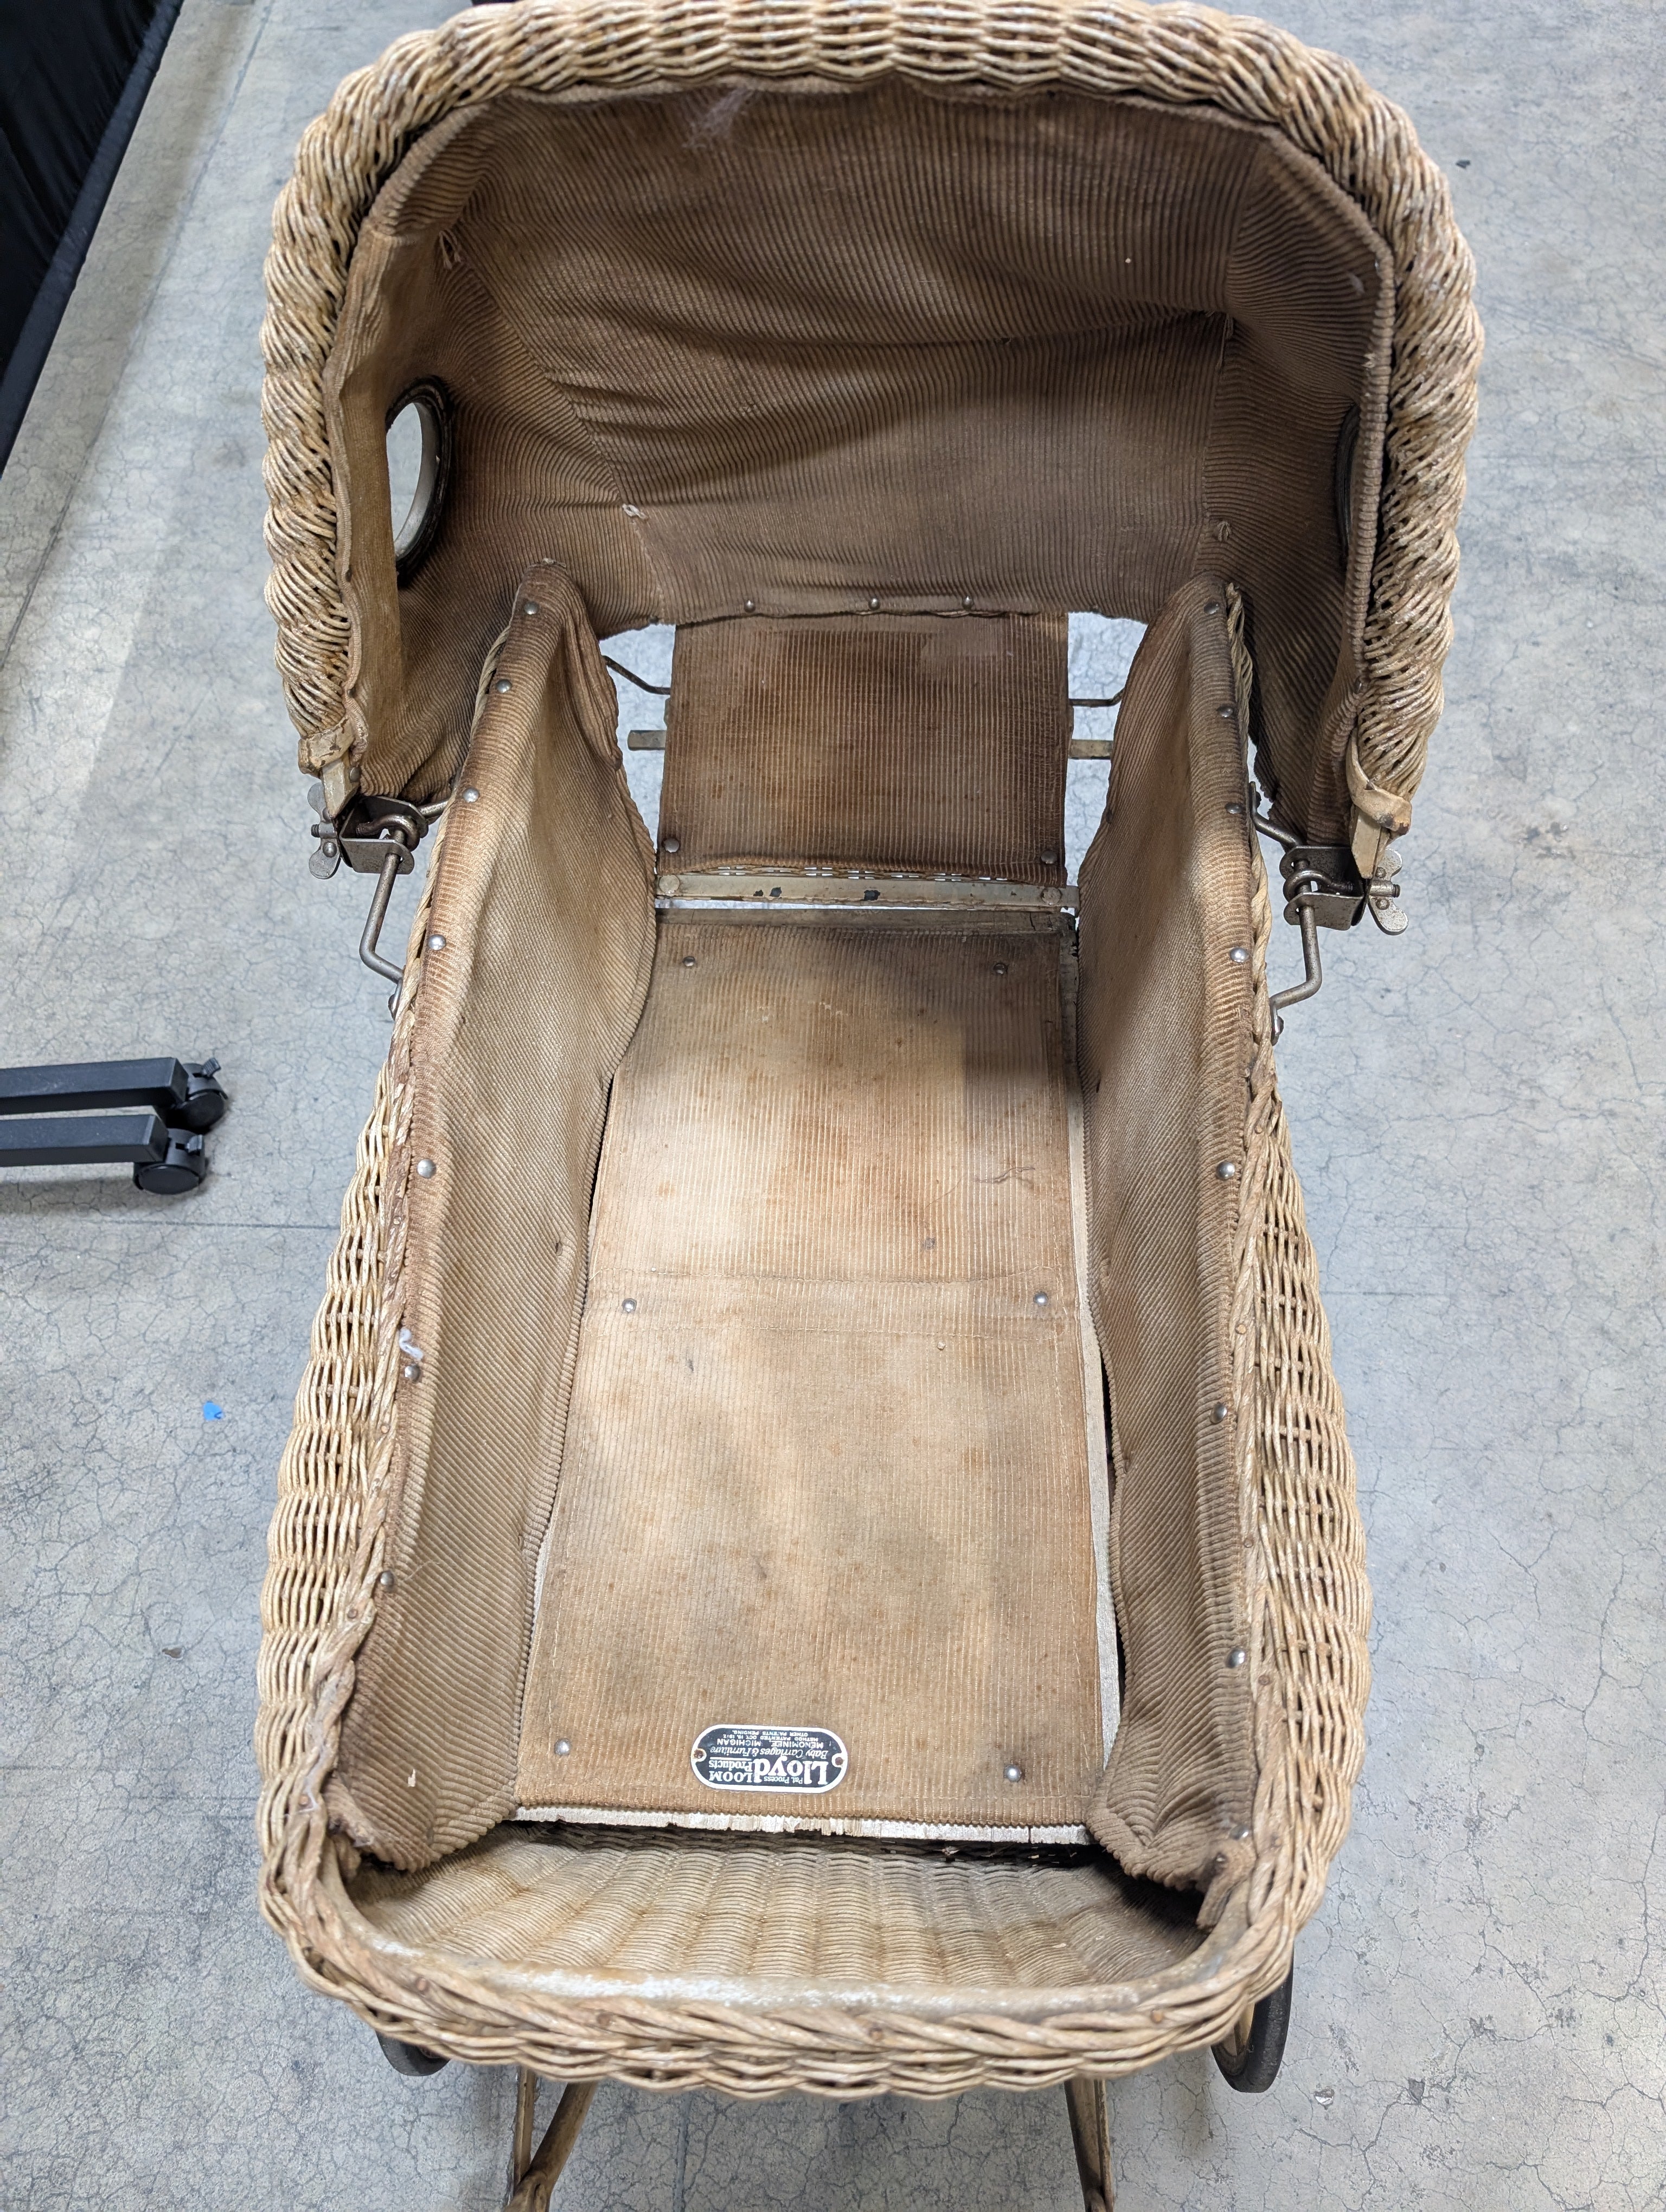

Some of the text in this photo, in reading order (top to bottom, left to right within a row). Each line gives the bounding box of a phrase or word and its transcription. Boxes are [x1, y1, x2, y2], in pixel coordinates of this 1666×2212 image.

[717, 1738, 761, 1746] MICHIGAN
[710, 1746, 829, 1759] Baby Carriages & Furniture
[709, 1760, 753, 1771] Products
[753, 1756, 829, 1785] Lloyd
[709, 1771, 753, 1783] LOOM
